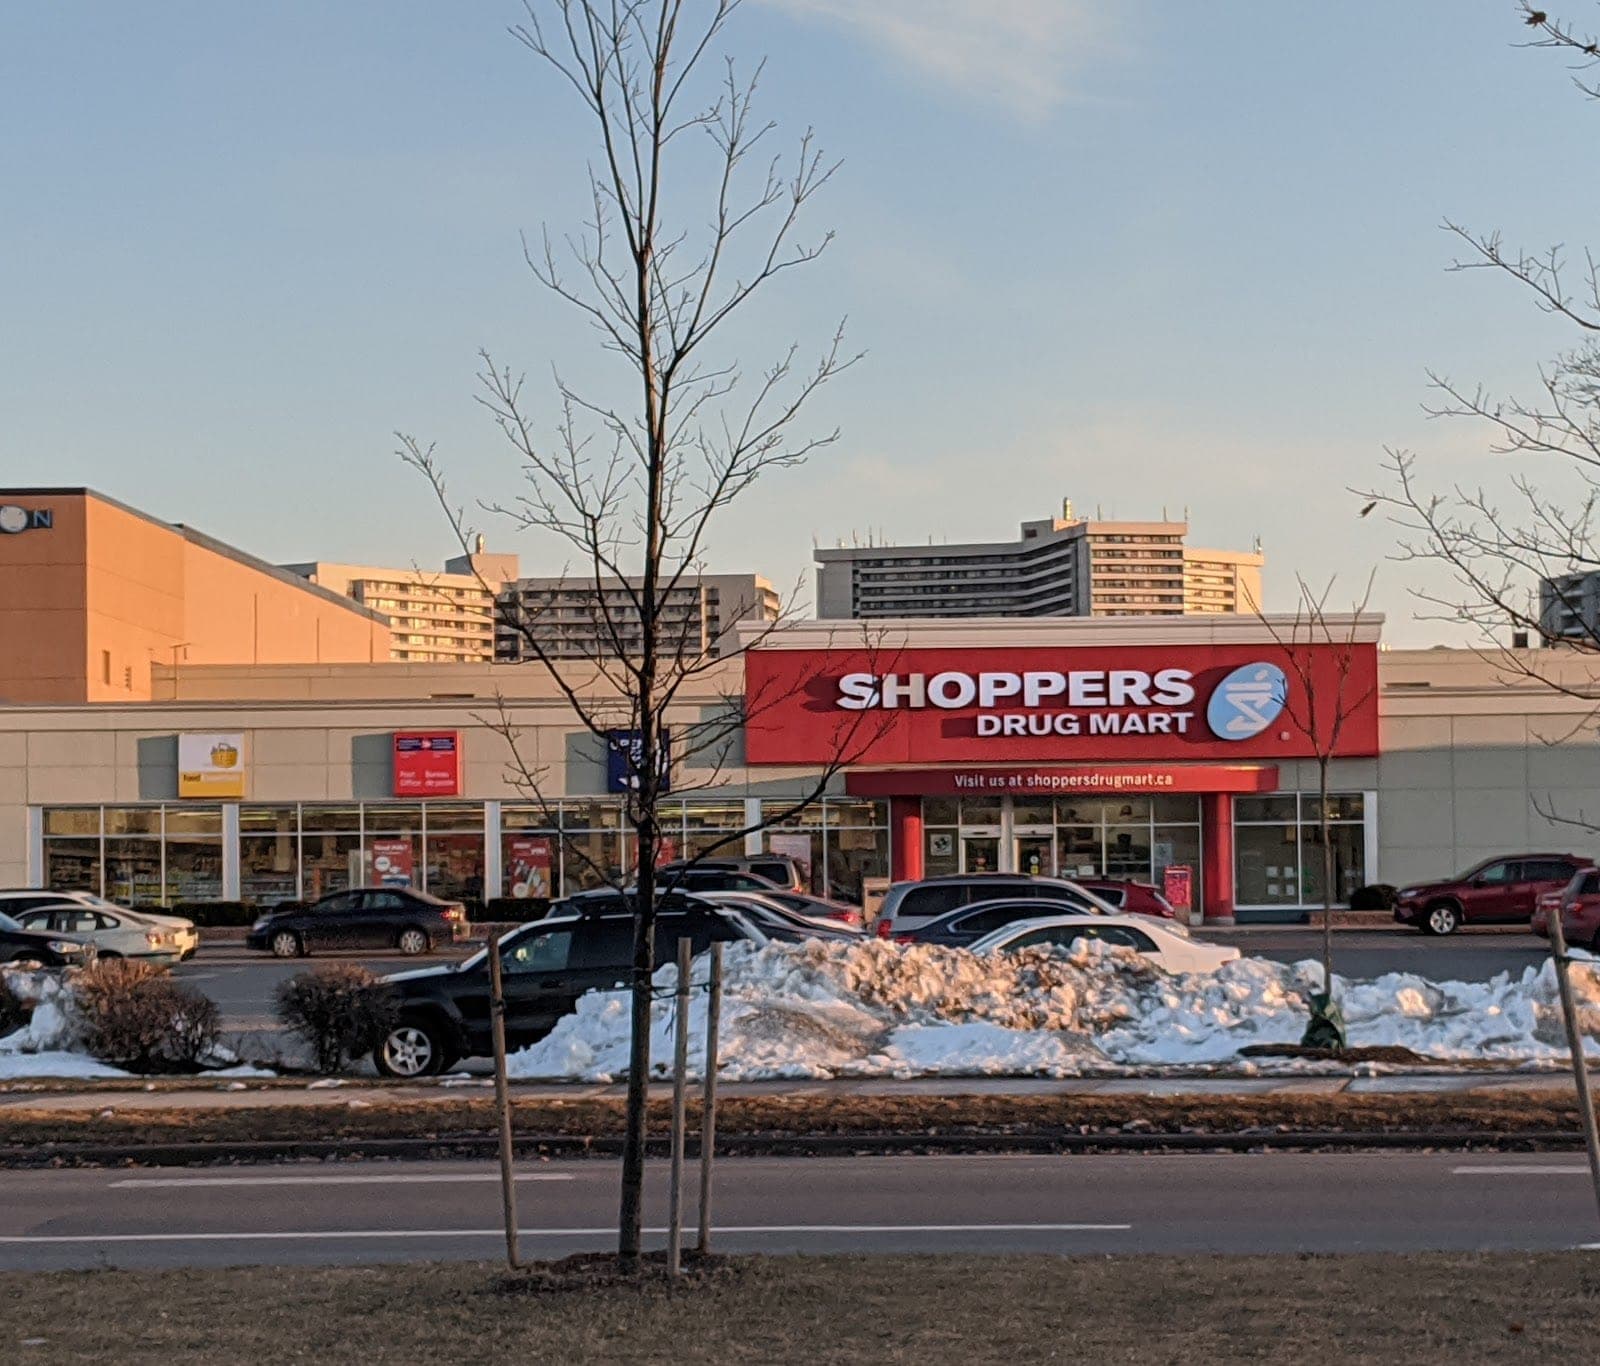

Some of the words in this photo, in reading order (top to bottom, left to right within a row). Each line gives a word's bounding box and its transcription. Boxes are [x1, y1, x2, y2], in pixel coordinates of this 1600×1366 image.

[836, 669, 1195, 710] SHOPPERS
[977, 714, 1080, 736] DRUG
[1089, 712, 1194, 734] MART
[955, 775, 985, 788] Visit
[990, 777, 1004, 787] us
[1009, 775, 1023, 786] at
[1027, 773, 1173, 788] shoppersdrugmart.ca
